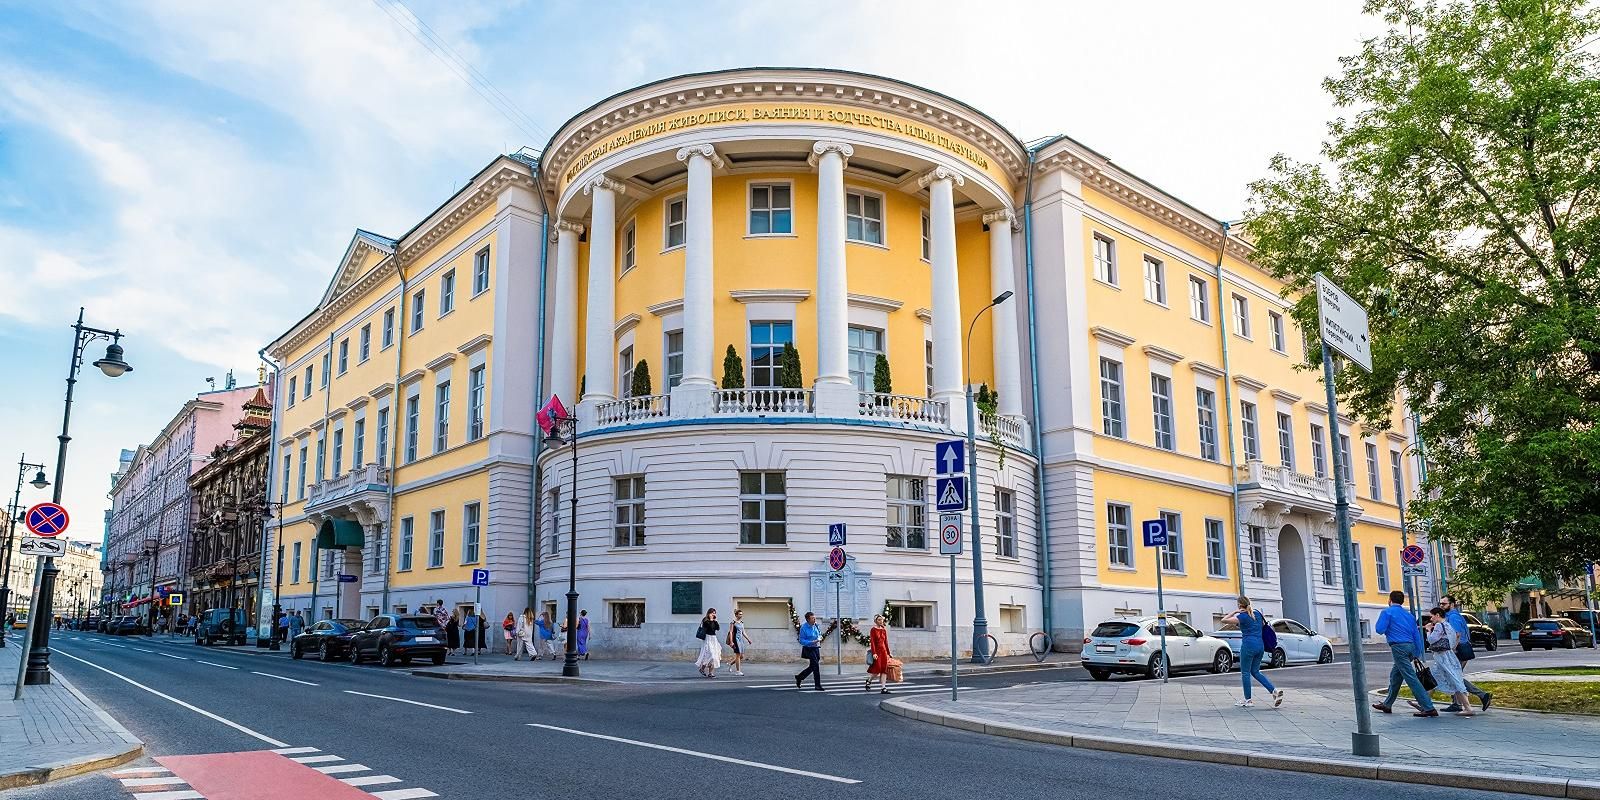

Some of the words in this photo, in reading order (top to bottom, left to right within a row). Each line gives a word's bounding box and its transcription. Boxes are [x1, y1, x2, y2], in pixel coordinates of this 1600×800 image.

[609, 121, 666, 151] АКАДЕМИЯ
[669, 109, 749, 130] ЖИВОПИСИ,
[752, 108, 811, 120] ВАЯНИЯ
[813, 108, 824, 121] И
[827, 110, 903, 133] ЗОДЧЕСТВА
[905, 124, 937, 144] ИЛЬИ
[945, 530, 956, 540] 30
